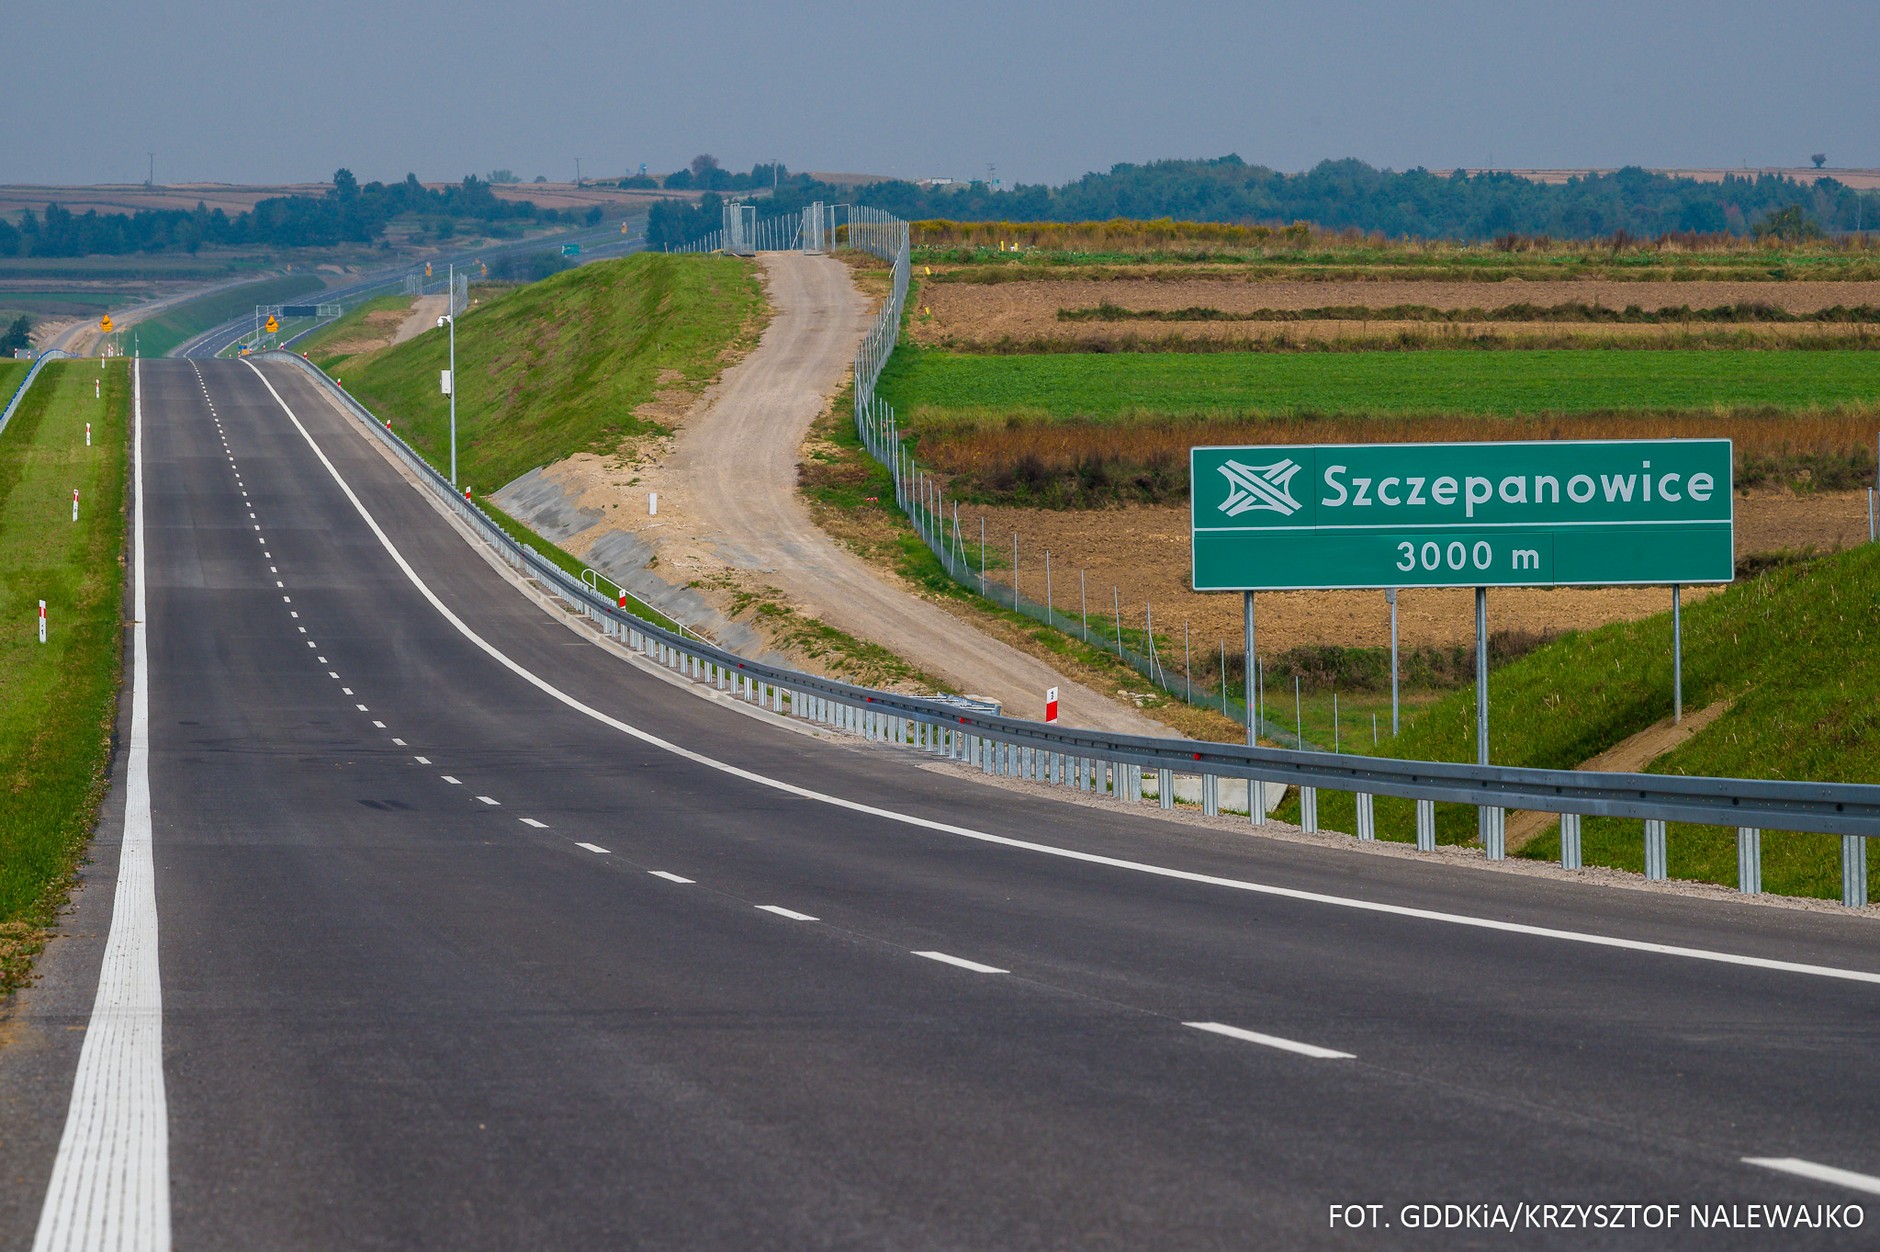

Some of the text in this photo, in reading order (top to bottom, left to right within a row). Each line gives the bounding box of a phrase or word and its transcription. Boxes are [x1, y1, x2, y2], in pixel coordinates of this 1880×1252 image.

[1322, 461, 1713, 517] Szczepanowice
[1397, 541, 1538, 571] 3000 m
